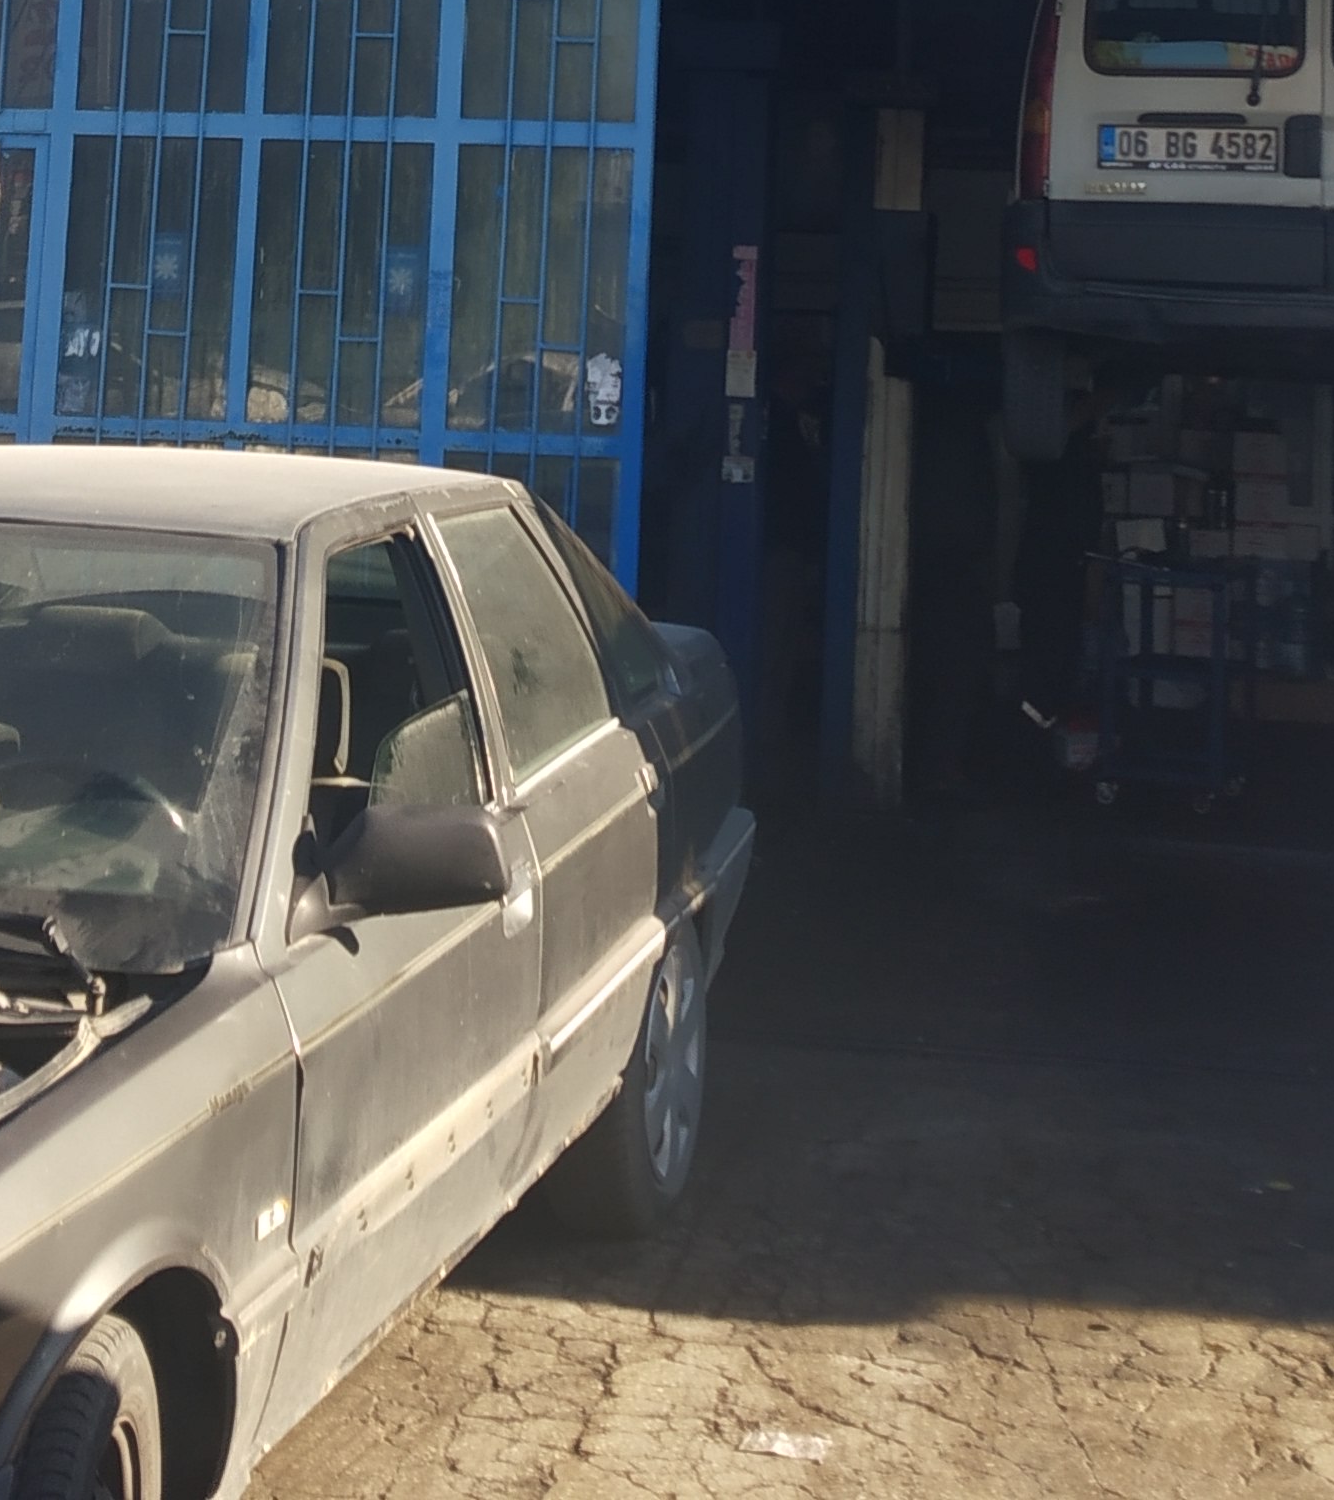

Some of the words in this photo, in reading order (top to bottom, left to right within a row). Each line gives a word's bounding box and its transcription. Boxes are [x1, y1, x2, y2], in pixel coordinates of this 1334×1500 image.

[1118, 130, 1149, 158] 06
[1165, 131, 1198, 159] BG
[1210, 132, 1274, 161] 4582
